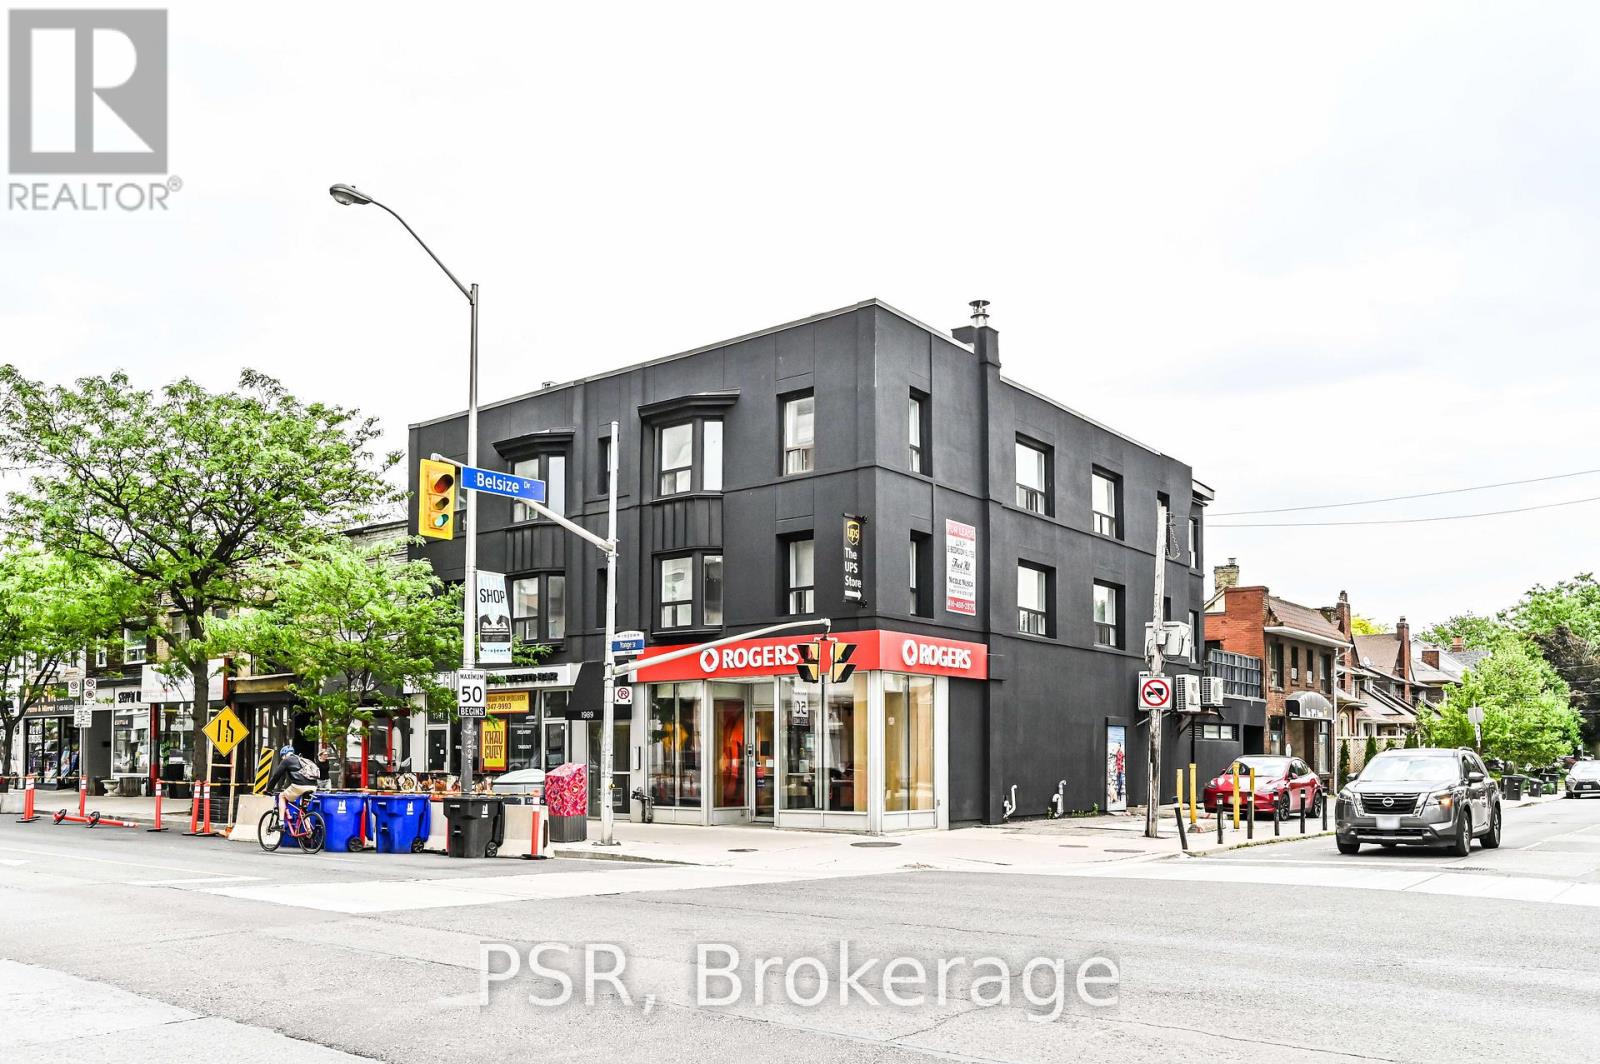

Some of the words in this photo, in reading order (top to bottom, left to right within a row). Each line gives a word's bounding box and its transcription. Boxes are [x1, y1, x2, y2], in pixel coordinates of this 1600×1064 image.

[476, 472, 520, 494] Belsize
[844, 547, 858, 560] The
[844, 561, 859, 574] UPS
[844, 575, 862, 588] Store
[479, 588, 505, 604] SHOP
[722, 644, 800, 669] ROGERS
[919, 644, 971, 669] ROGERS
[461, 686, 483, 703] 50
[460, 707, 484, 716] BEGINS
[581, 710, 594, 719] 1989
[484, 730, 503, 745] KHAU
